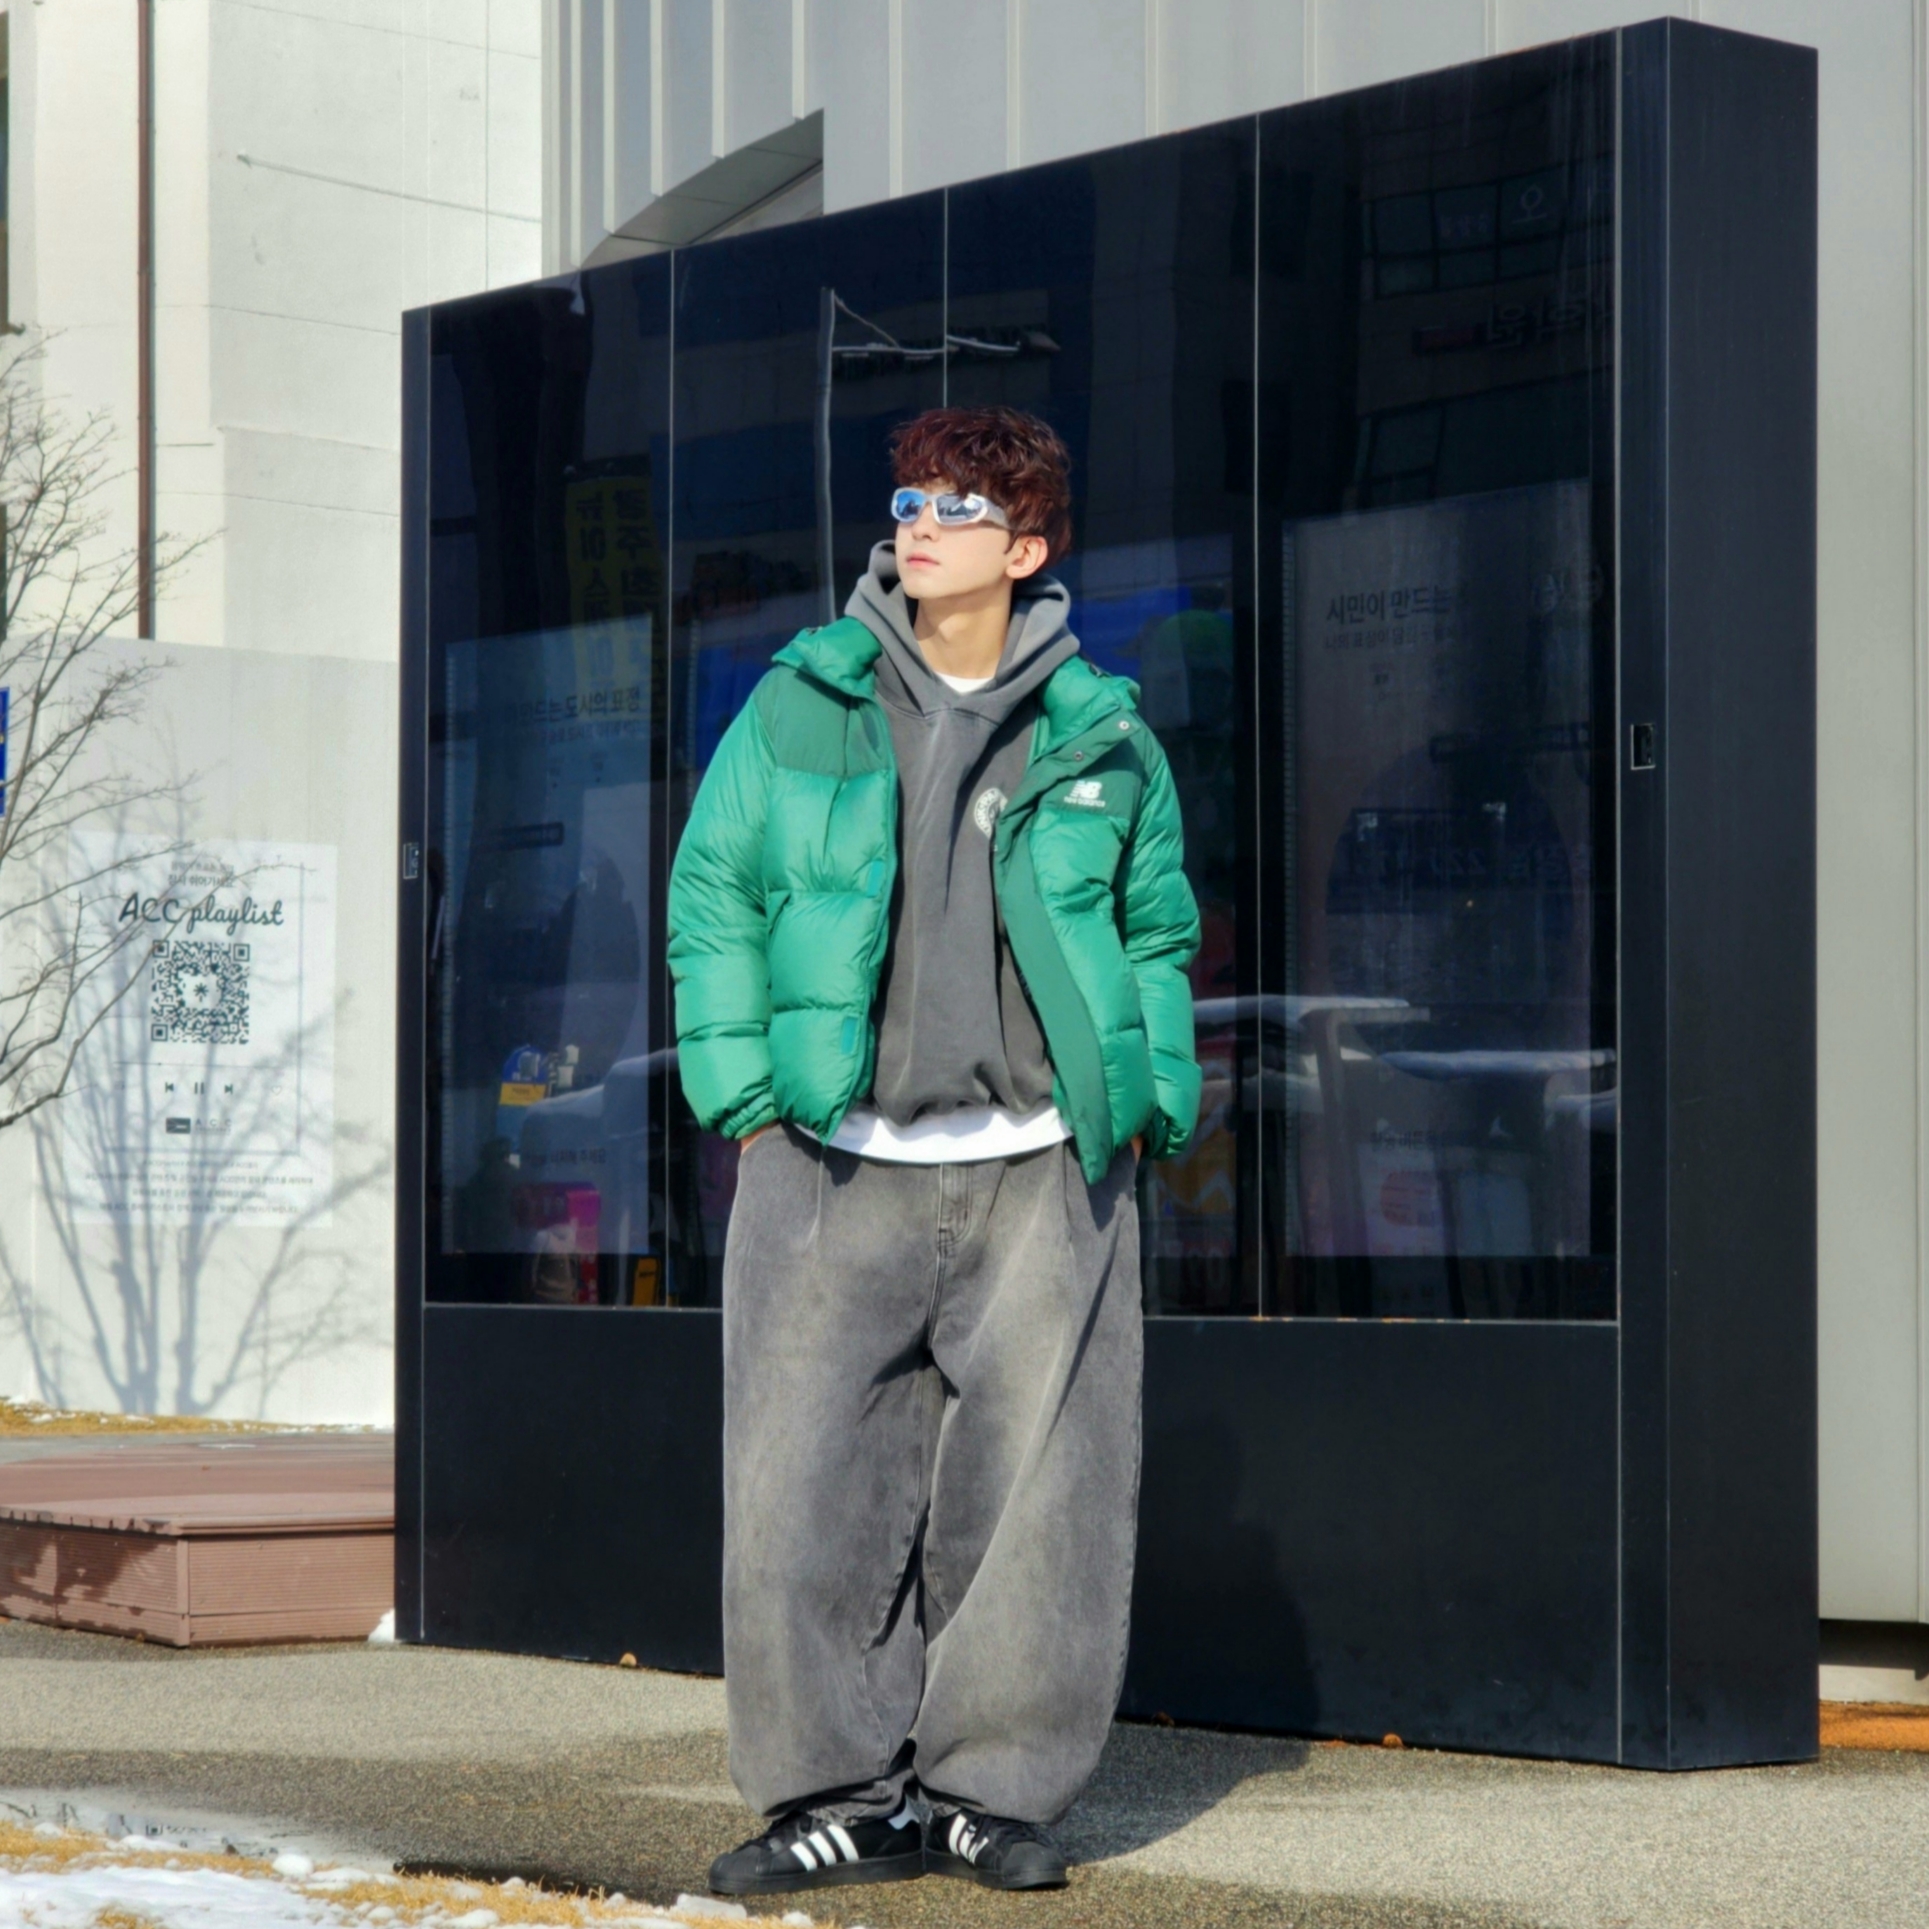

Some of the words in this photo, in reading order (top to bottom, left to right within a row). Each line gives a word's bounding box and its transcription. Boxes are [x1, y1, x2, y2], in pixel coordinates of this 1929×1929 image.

[1326, 590, 1385, 625] 시민이
[1390, 585, 1451, 620] 만드는
[564, 691, 608, 719] 도시의
[610, 685, 641, 713] 표정
[118, 892, 180, 924] ACC
[186, 894, 284, 936] playlist
